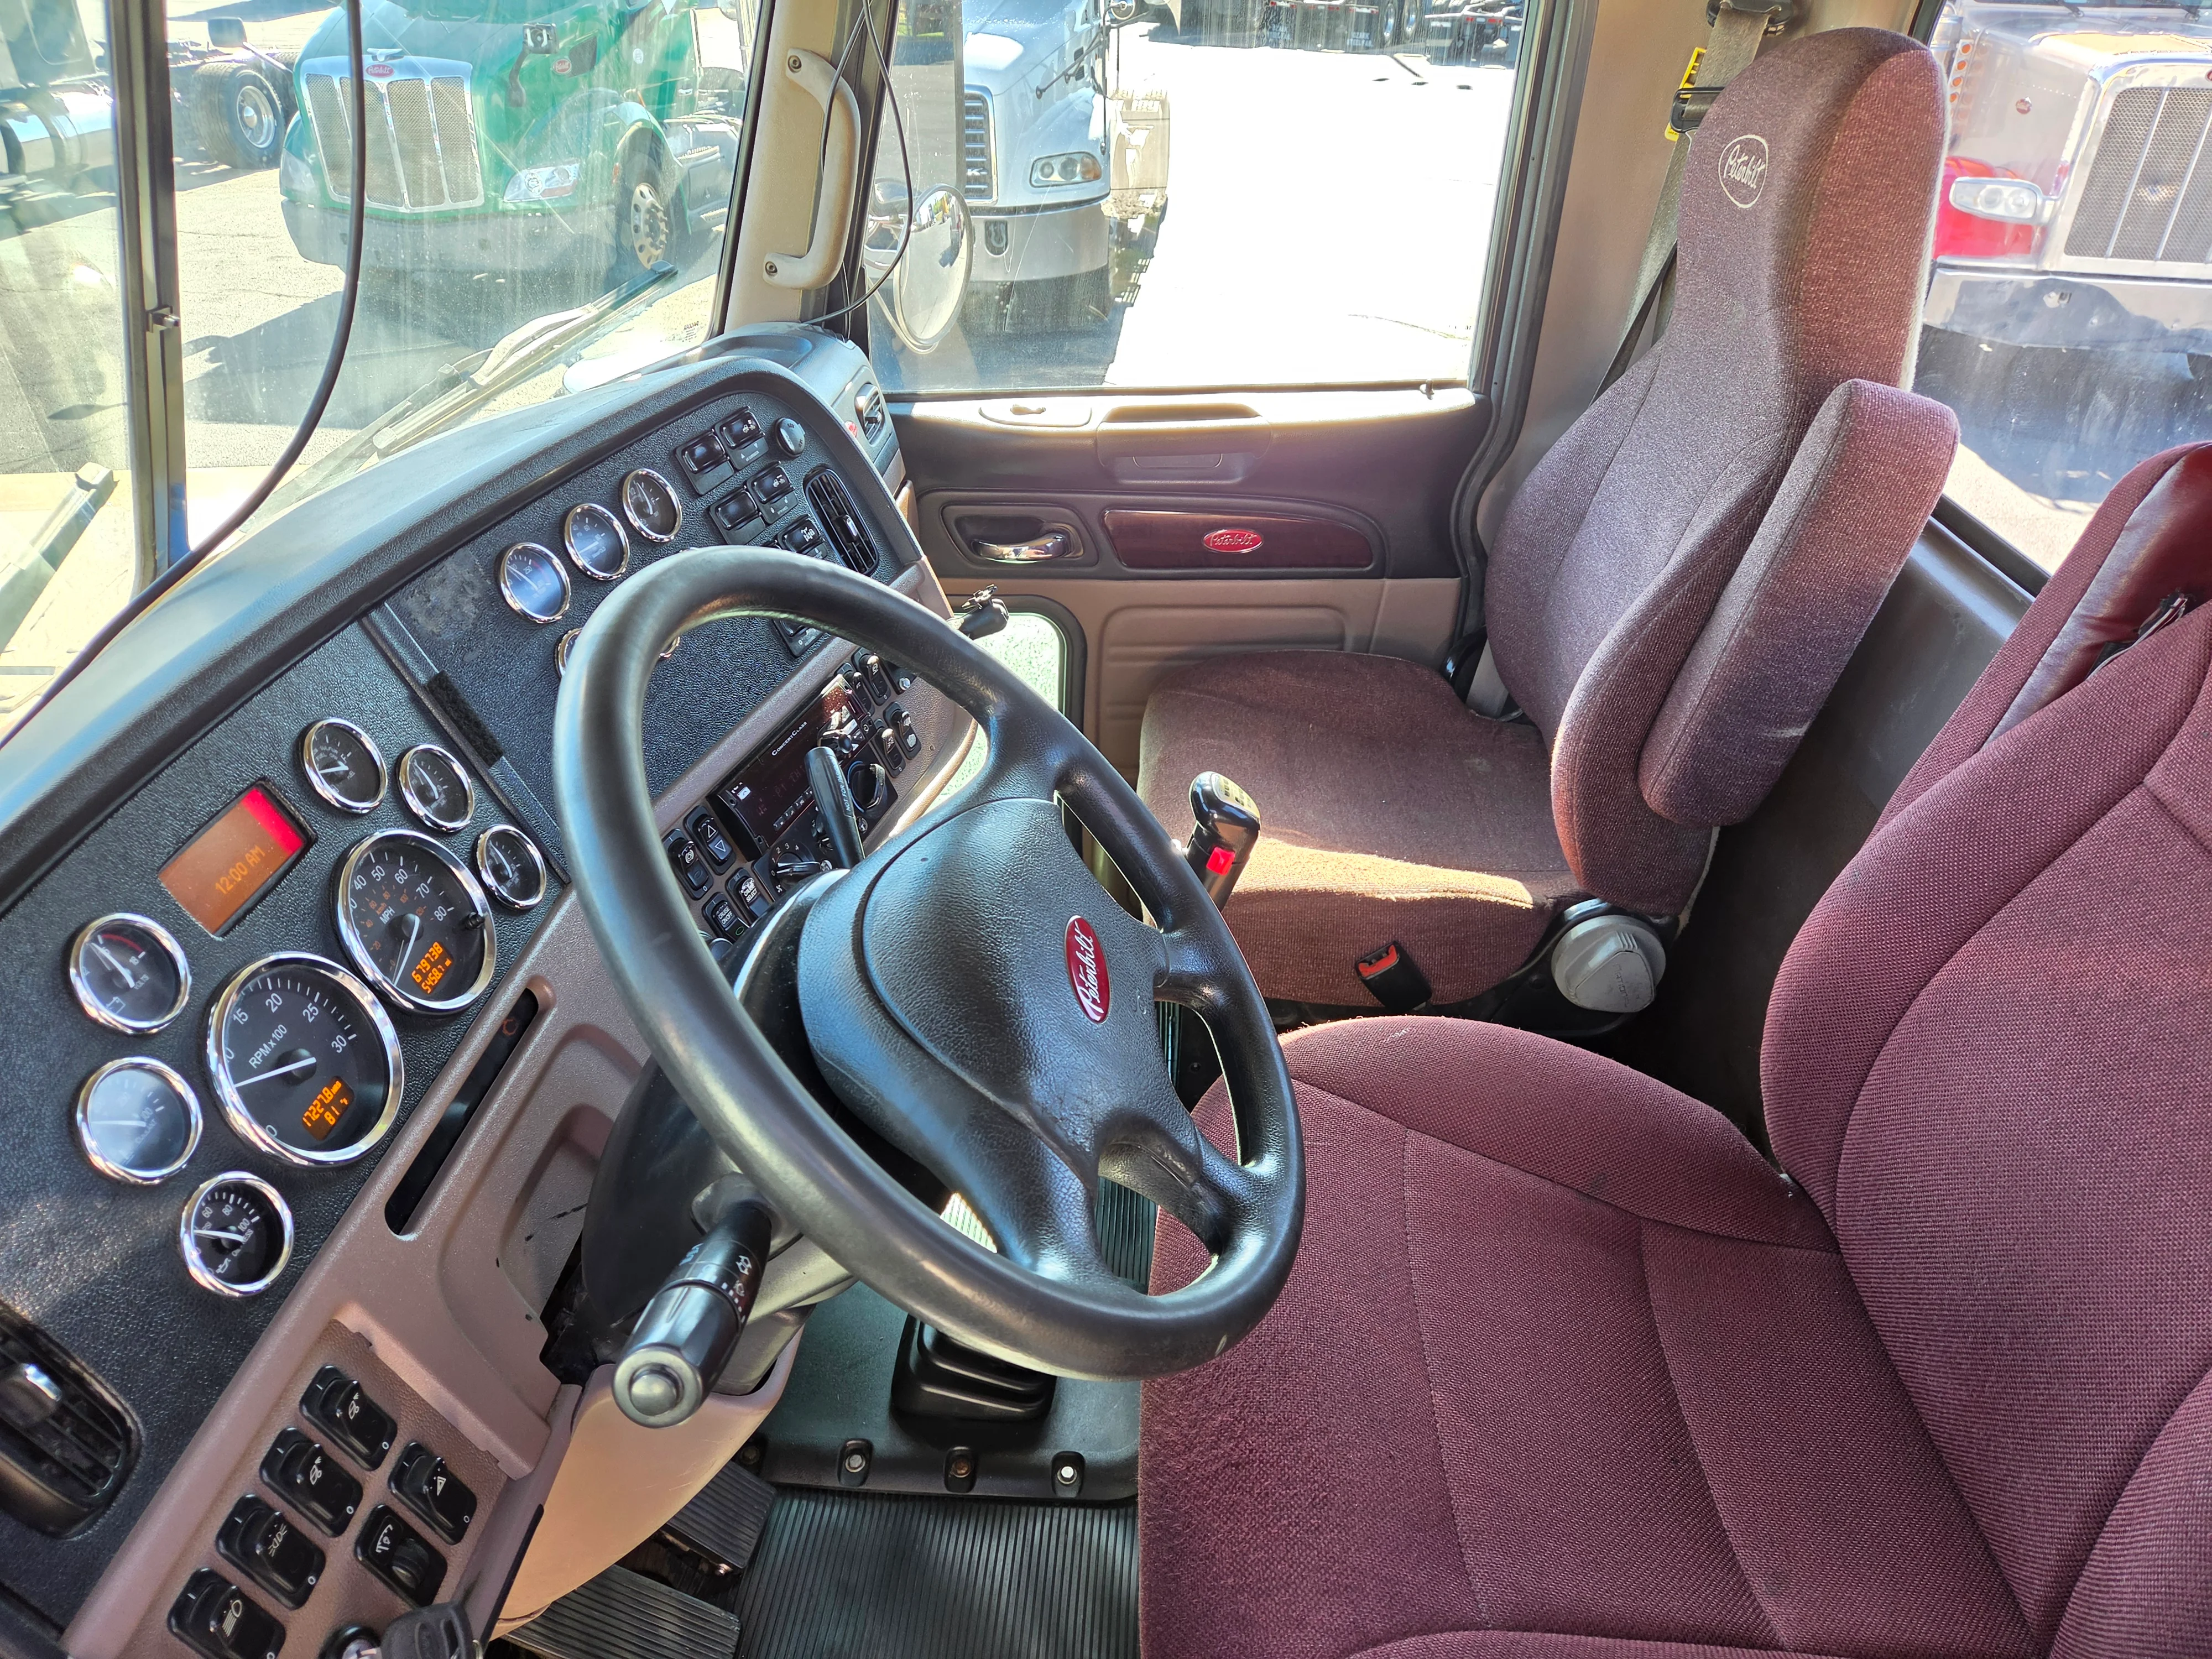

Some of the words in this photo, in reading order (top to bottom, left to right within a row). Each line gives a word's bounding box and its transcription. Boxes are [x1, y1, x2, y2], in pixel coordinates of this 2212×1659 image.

[1723, 144, 1766, 189] Peterbilt
[1210, 533, 1257, 546] Peterbilt
[341, 753, 347, 764] F
[215, 861, 249, 894] 12:00
[244, 844, 266, 867] AM
[371, 865, 385, 881] 50
[394, 868, 408, 884] 60
[353, 874, 367, 890] 40
[416, 883, 430, 899] 70
[746, 890, 758, 902] SELECT
[379, 906, 395, 925] MPH
[434, 906, 447, 921] 80
[718, 907, 730, 920] CRUISE
[411, 942, 443, 983] 679738
[1074, 920, 1104, 1021] Peterbilt
[265, 993, 283, 1013] 20
[233, 1008, 249, 1025] 15
[302, 1003, 319, 1023] 25
[248, 1042, 271, 1069] RPM
[272, 1024, 288, 1042] 100
[331, 1035, 347, 1053] 30
[324, 1105, 341, 1125] 81
[202, 1207, 213, 1218] 60
[222, 1204, 233, 1216] 80
[238, 1218, 250, 1232] 100
